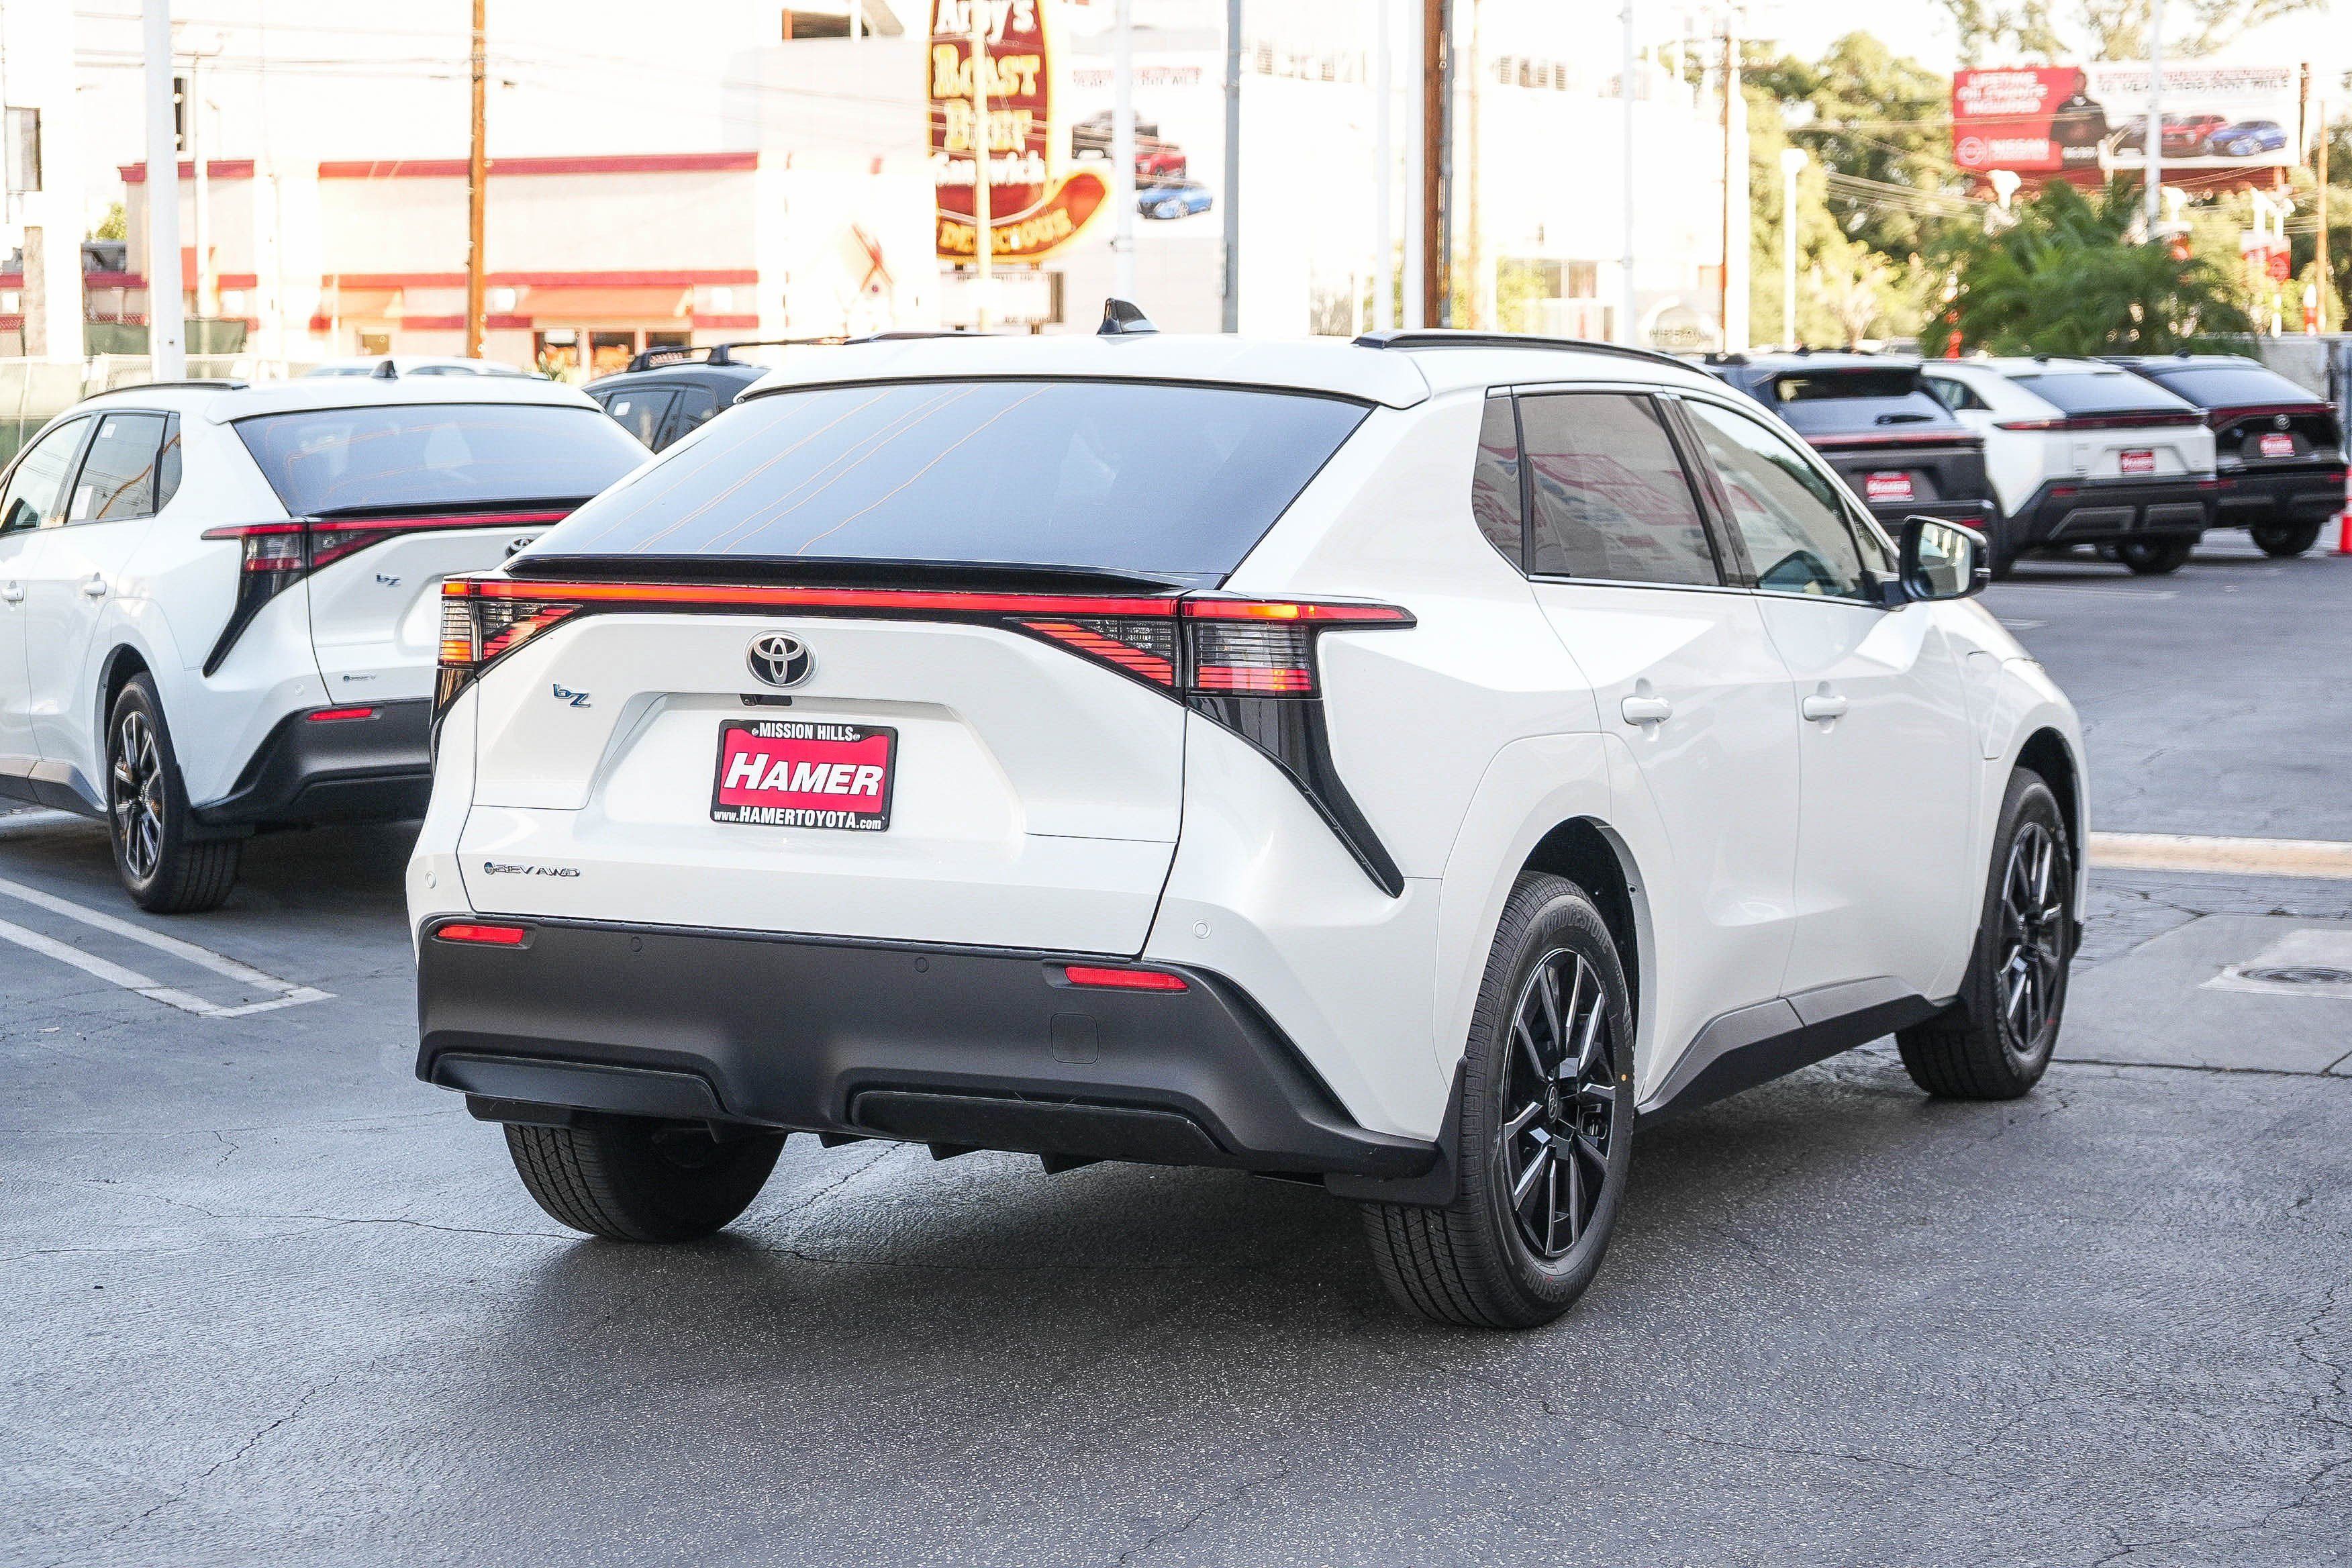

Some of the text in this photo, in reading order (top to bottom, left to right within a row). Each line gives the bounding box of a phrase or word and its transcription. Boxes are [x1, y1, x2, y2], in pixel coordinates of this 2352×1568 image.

[759, 723, 853, 742] MISSION HILLS
[724, 752, 885, 796] HAMER
[714, 806, 882, 830] www.HAMERTOYOTA.com
[535, 866, 581, 878] AWD
